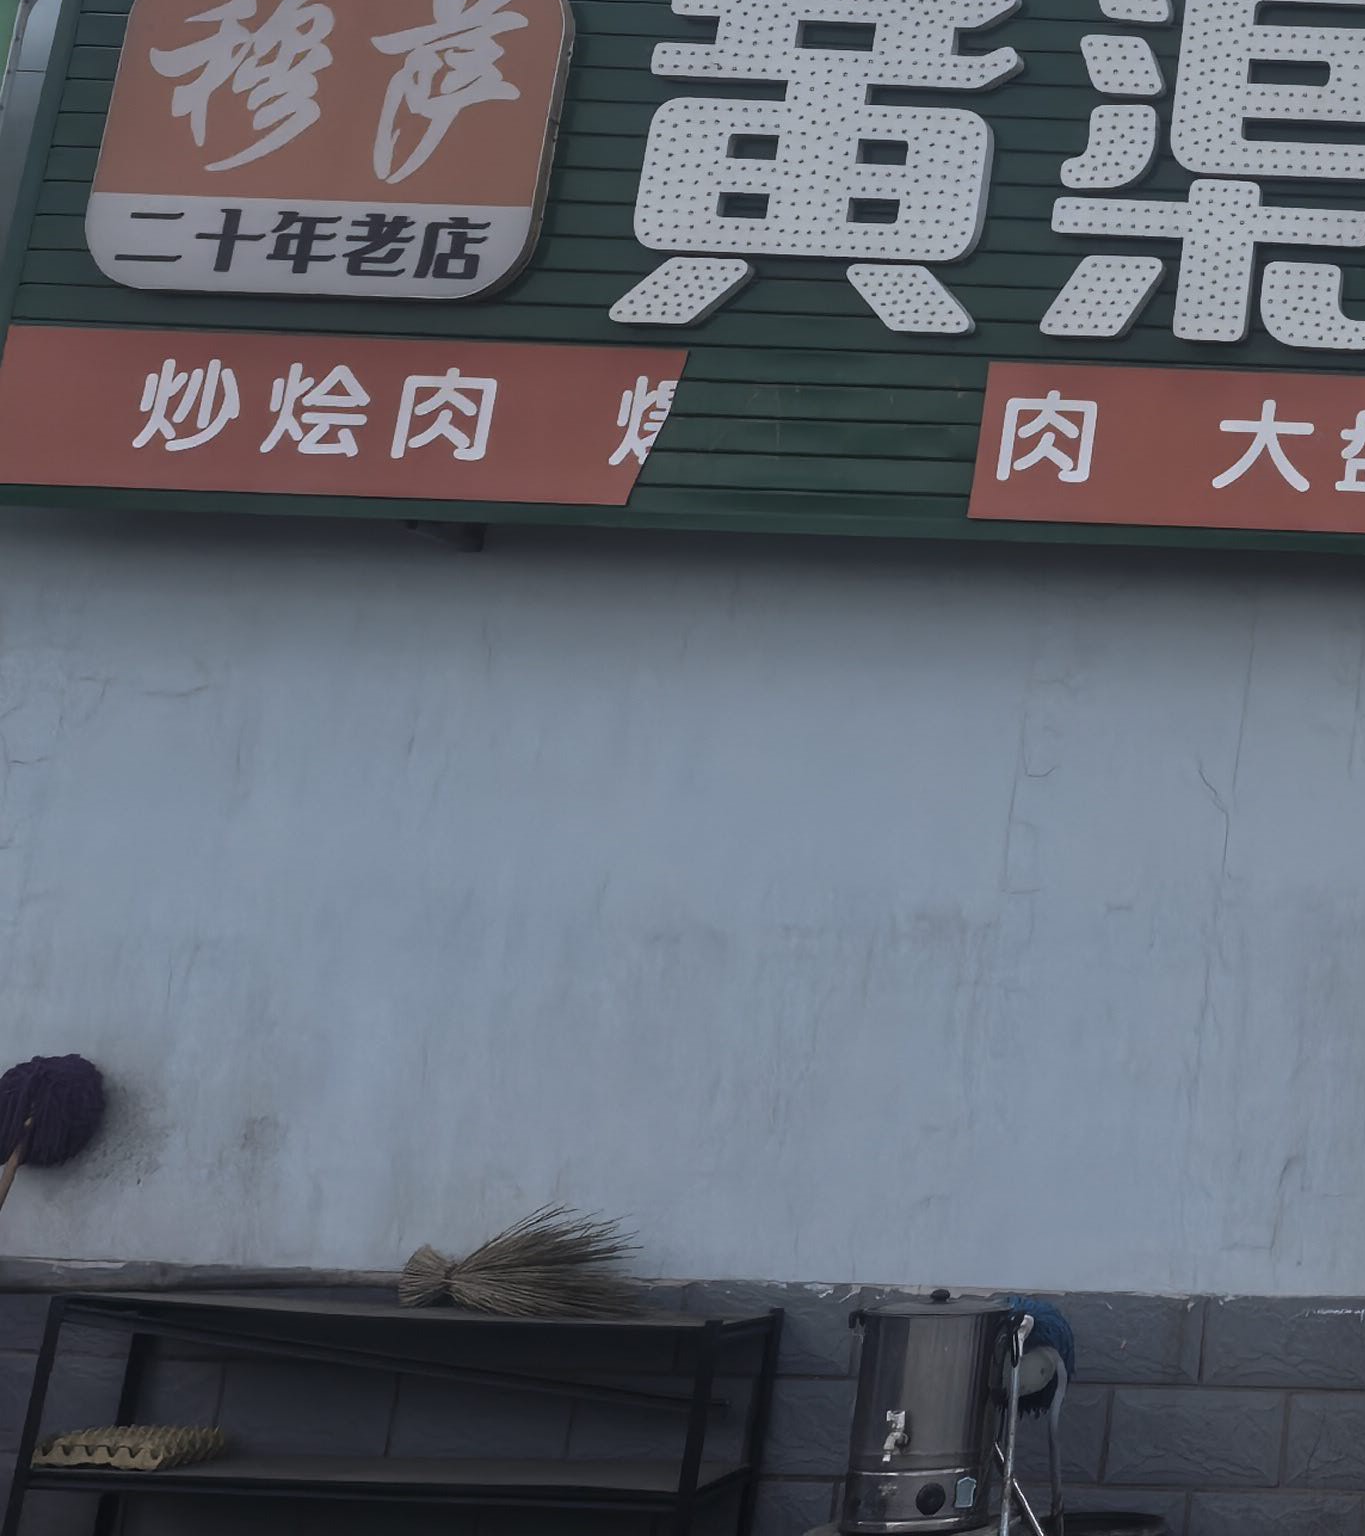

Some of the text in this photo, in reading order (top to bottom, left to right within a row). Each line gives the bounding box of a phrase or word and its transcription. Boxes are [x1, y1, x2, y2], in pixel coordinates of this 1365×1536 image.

[114, 208, 491, 279] 二十年老店
[132, 358, 498, 460] 炒烩肉
[995, 396, 1097, 481] 肉
